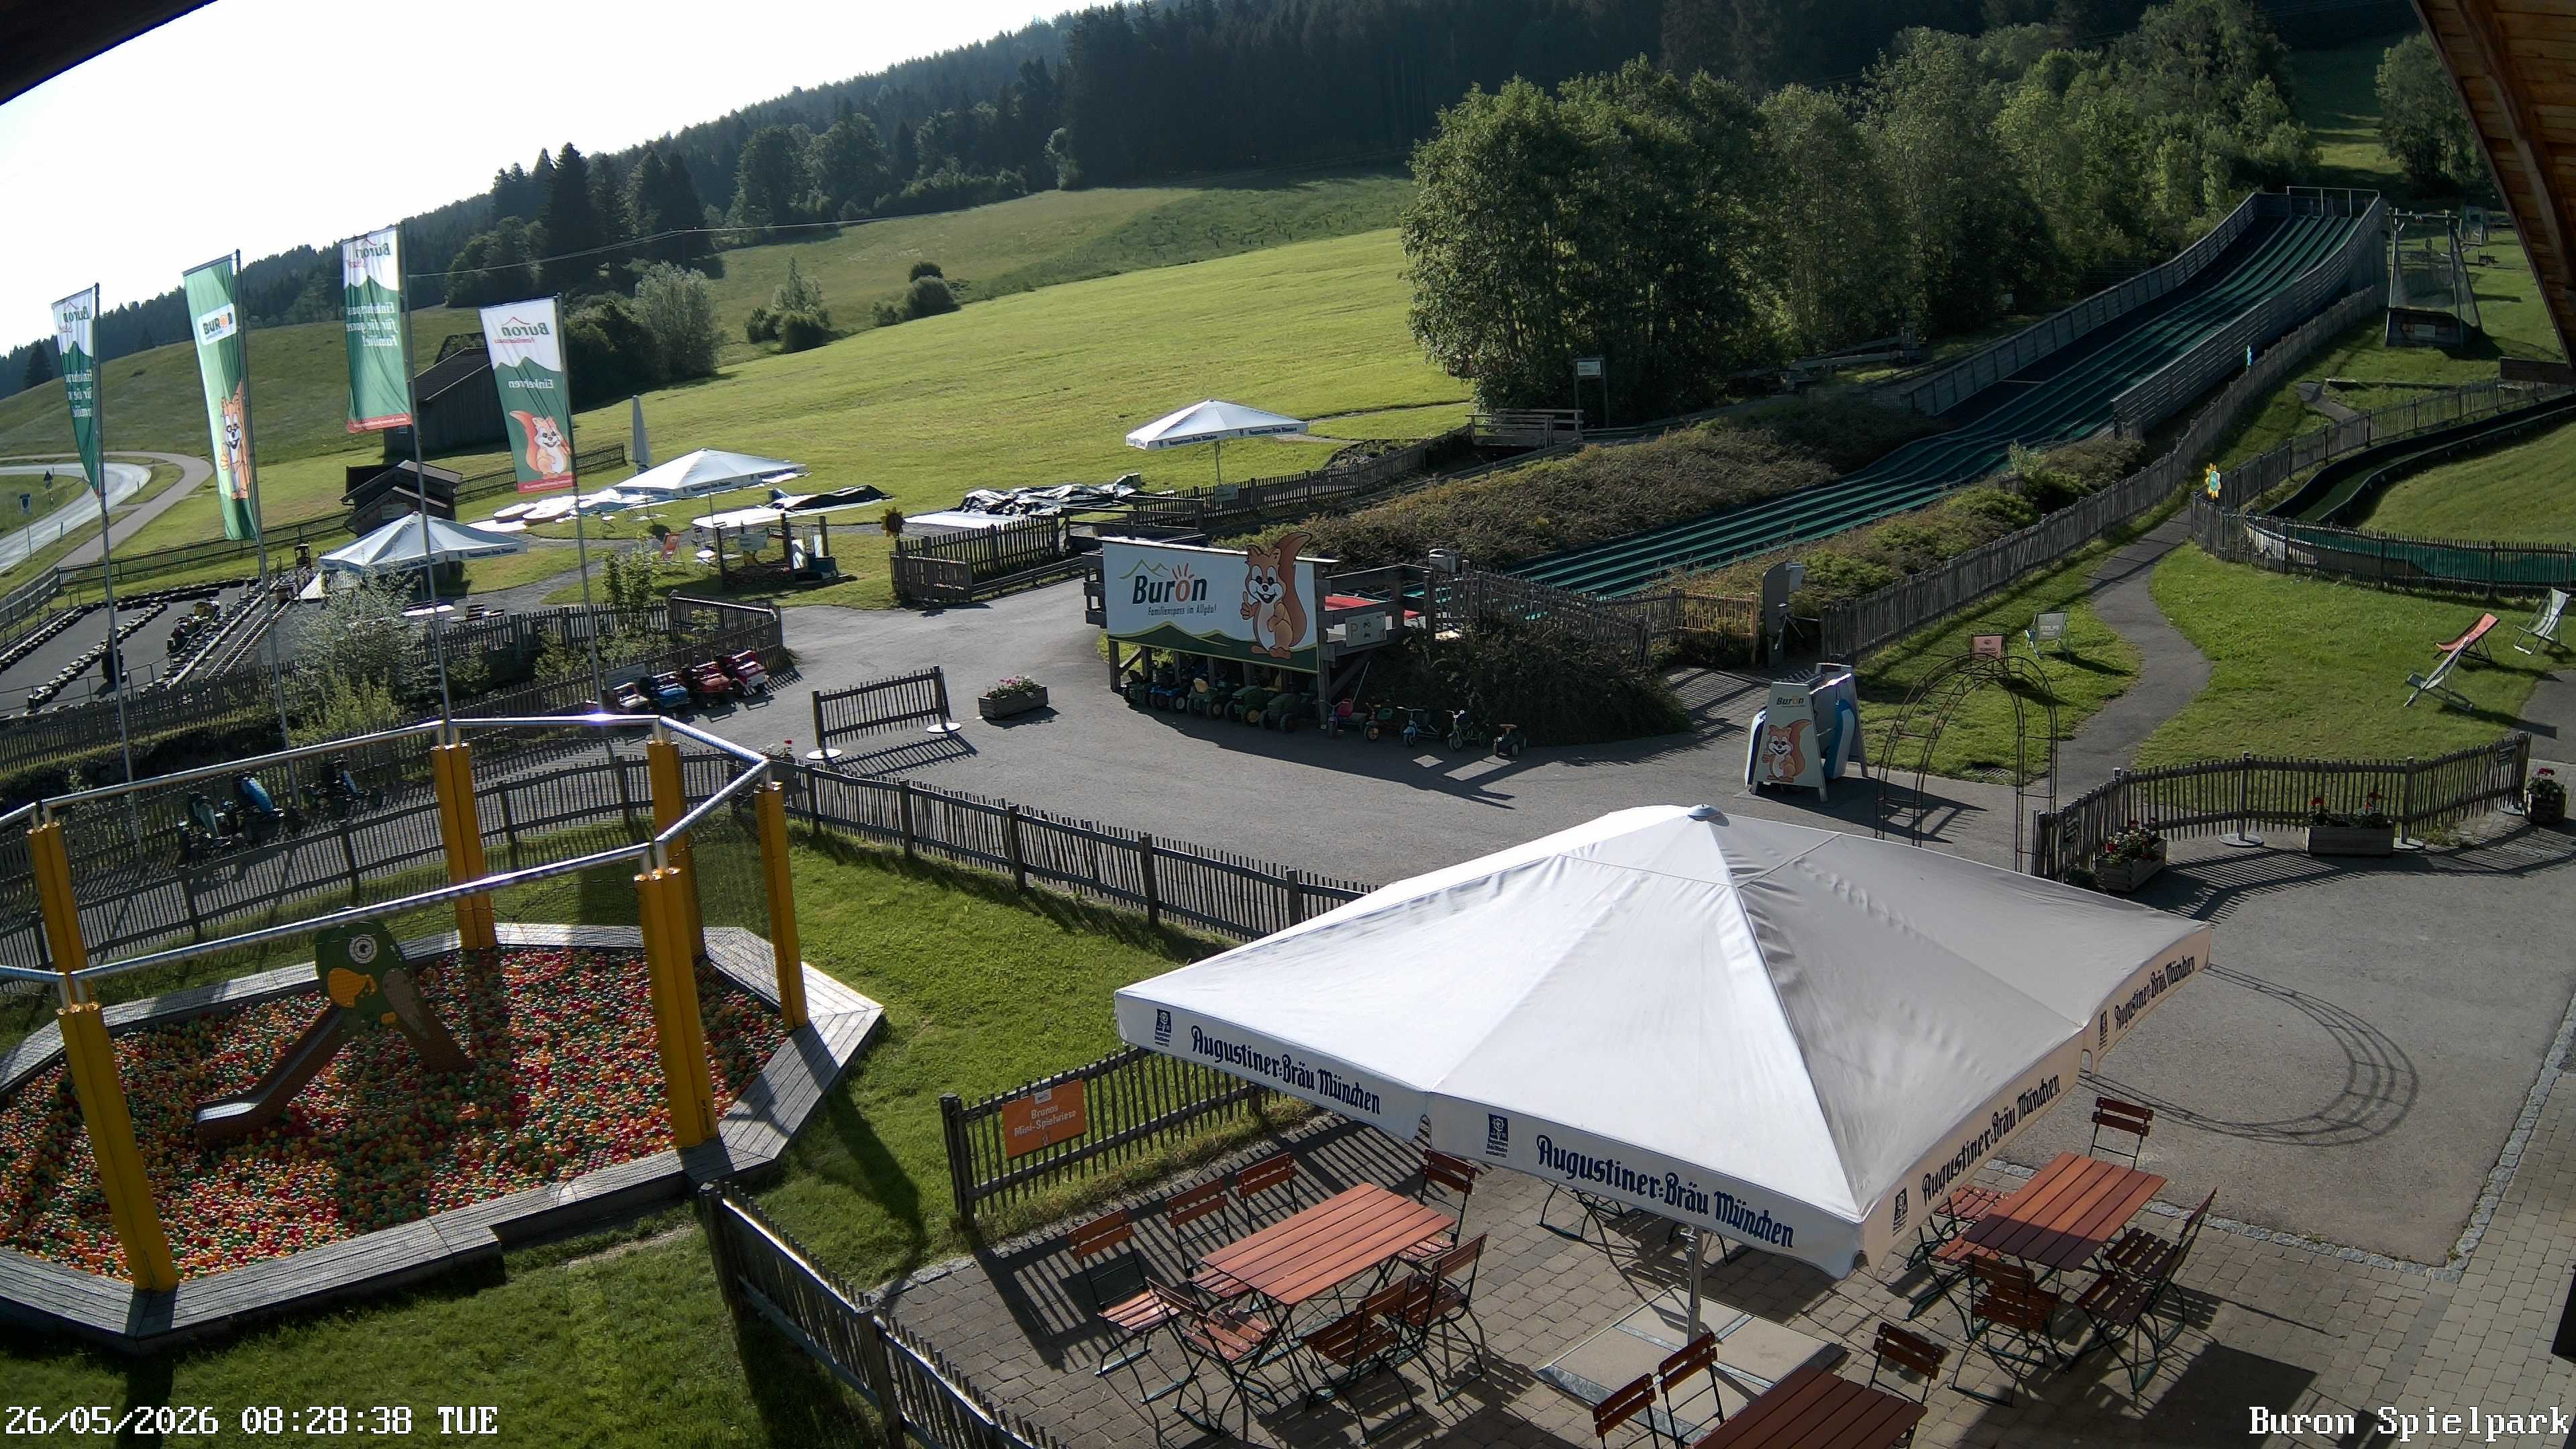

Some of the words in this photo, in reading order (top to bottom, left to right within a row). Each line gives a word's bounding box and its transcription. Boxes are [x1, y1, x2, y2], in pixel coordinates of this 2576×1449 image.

[1132, 574, 1208, 604] Buron
[1776, 697, 1805, 705] Buron
[2165, 955, 2195, 987] München
[1319, 1068, 1381, 1115] München
[2017, 1075, 2061, 1123] München
[1714, 1191, 1794, 1248] München
